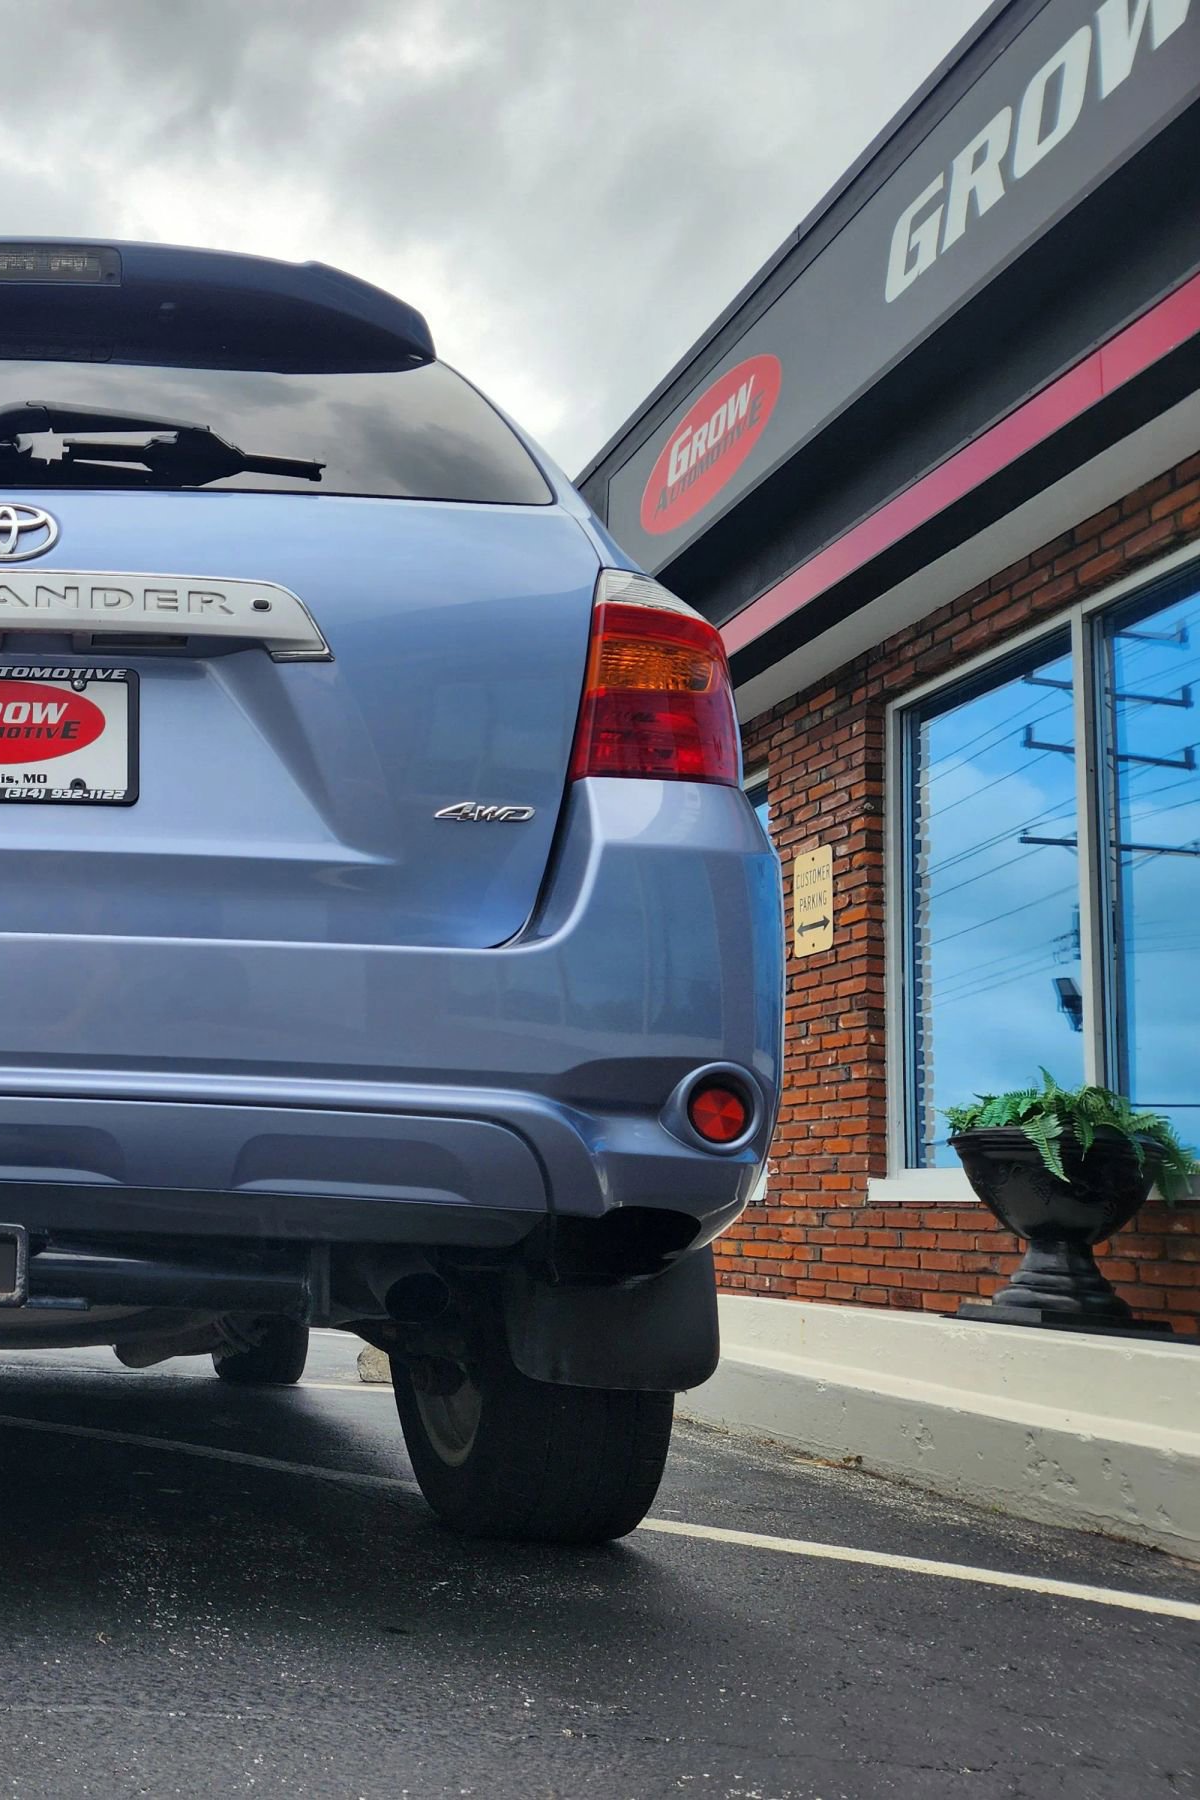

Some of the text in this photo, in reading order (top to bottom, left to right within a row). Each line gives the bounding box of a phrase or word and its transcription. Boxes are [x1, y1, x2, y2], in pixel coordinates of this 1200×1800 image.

[885, 0, 1191, 303] GROW
[667, 374, 755, 488] GROW
[654, 388, 765, 520] AUTOMOTIVE
[23, 774, 48, 784] MO
[4, 788, 46, 799] (314)
[50, 789, 126, 800] 932-1122
[434, 801, 536, 821] 4WD
[796, 864, 831, 890] CUSTOMER
[799, 890, 828, 913] PARKING
